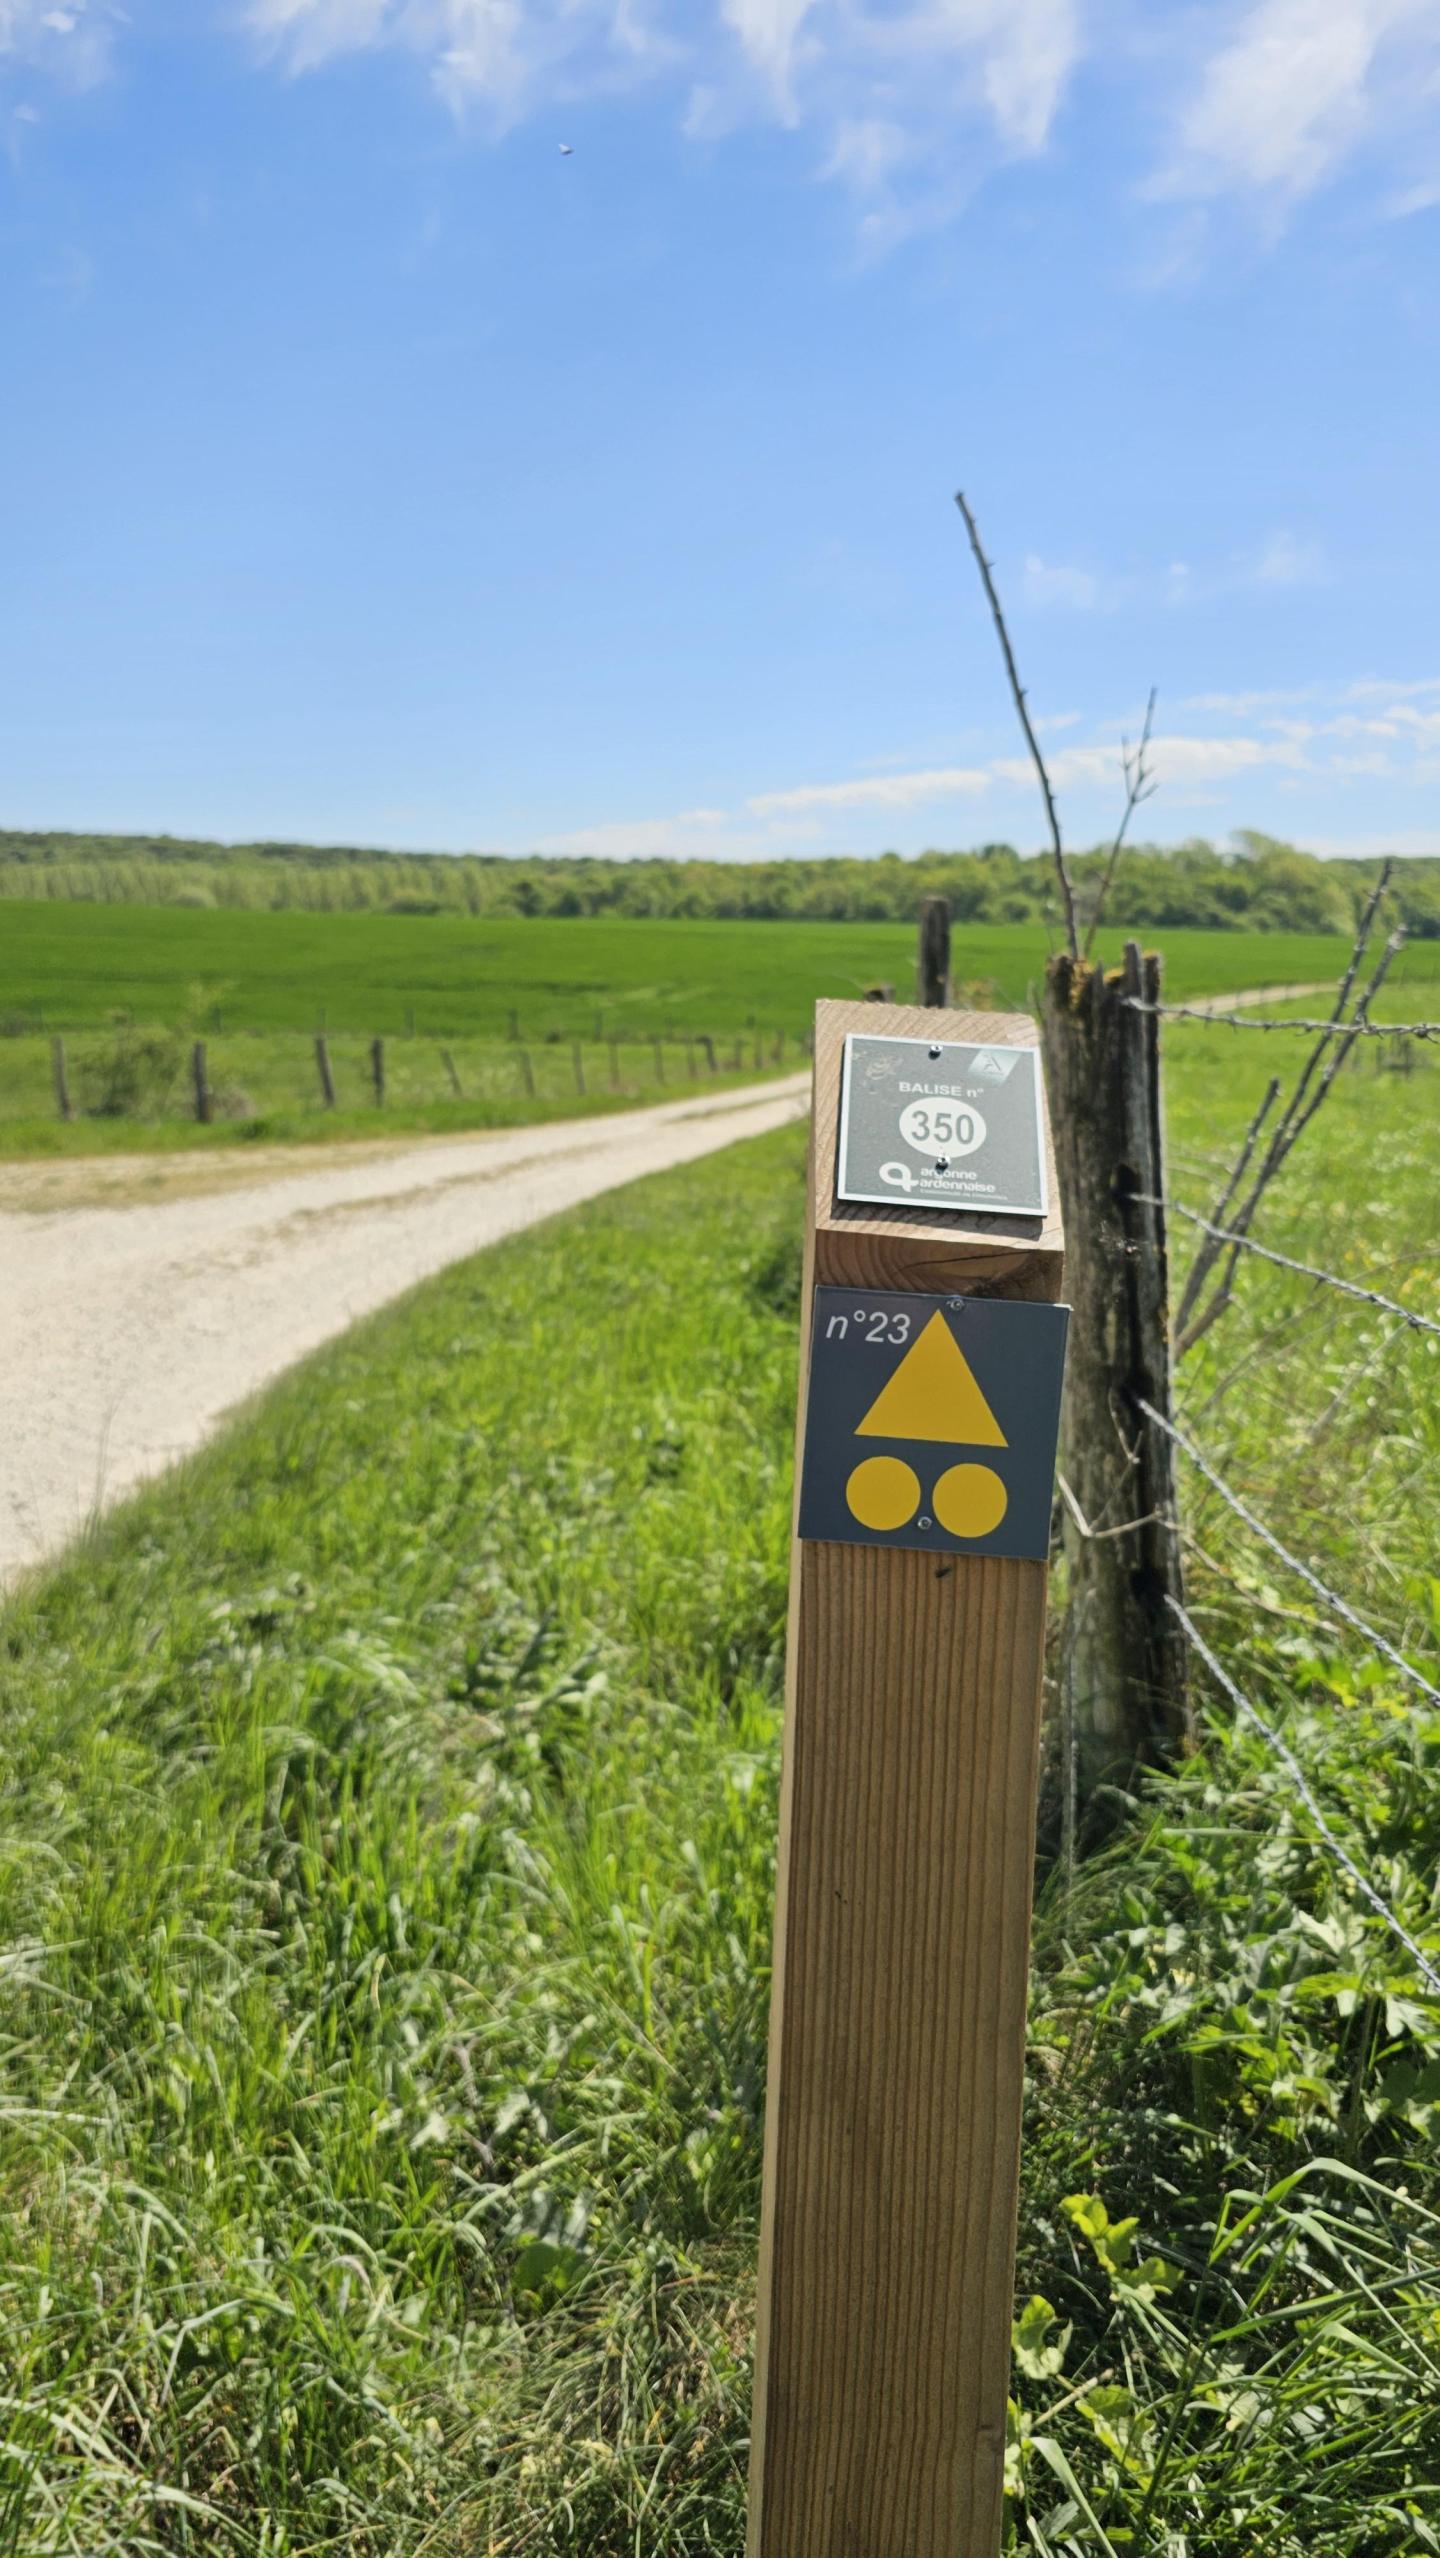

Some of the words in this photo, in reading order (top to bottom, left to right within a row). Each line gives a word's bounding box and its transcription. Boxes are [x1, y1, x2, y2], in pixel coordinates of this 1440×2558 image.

[898, 1081, 962, 1097] BALISE
[911, 1110, 974, 1145] 350
[919, 1177, 996, 1193] ardennaise
[826, 1309, 911, 1344] n°23
